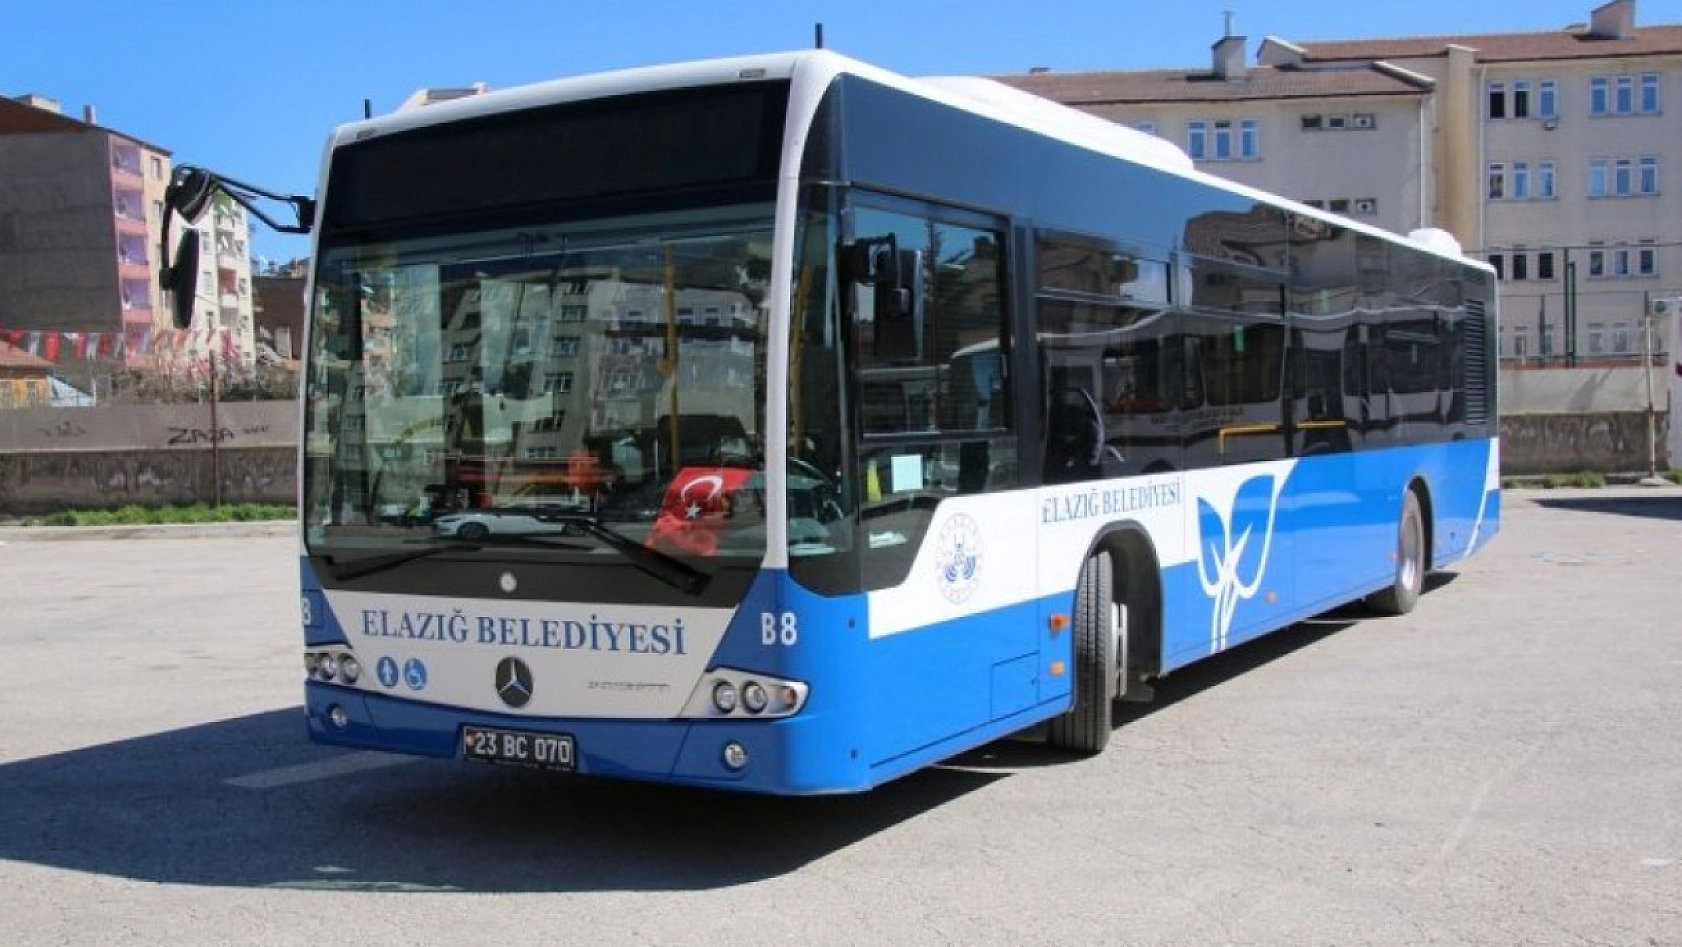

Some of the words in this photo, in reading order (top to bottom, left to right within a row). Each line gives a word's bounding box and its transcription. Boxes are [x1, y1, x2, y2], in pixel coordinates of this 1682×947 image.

[1042, 488, 1100, 523] ELAZIĞ
[1102, 476, 1181, 515] BELEDİYESİ
[361, 608, 468, 643] ELAZIĞ
[477, 613, 687, 655] BELEDİYESİ
[761, 612, 798, 646] B8
[475, 732, 497, 755] 23
[503, 735, 527, 758] BC
[535, 738, 570, 763] 070
